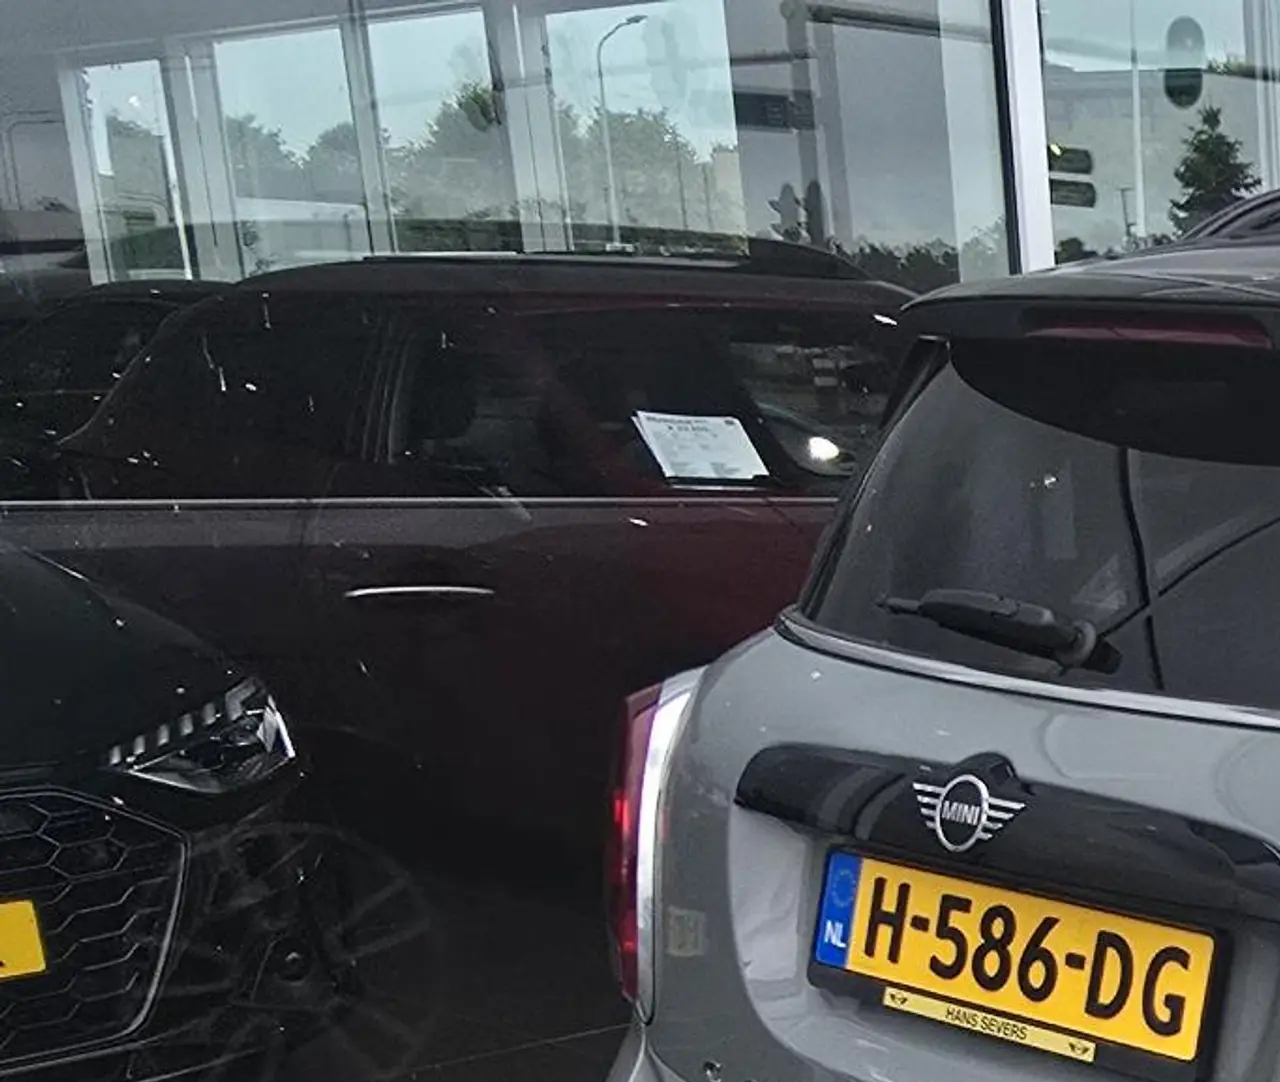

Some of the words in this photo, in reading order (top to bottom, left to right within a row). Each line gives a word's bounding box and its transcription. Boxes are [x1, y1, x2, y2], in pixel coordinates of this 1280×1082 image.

[941, 800, 981, 826] MINI
[823, 919, 847, 948] NL
[864, 876, 1192, 1038] H-586-DG
[945, 1006, 979, 1029] HANS
[979, 1014, 1029, 1041] SEVERS
